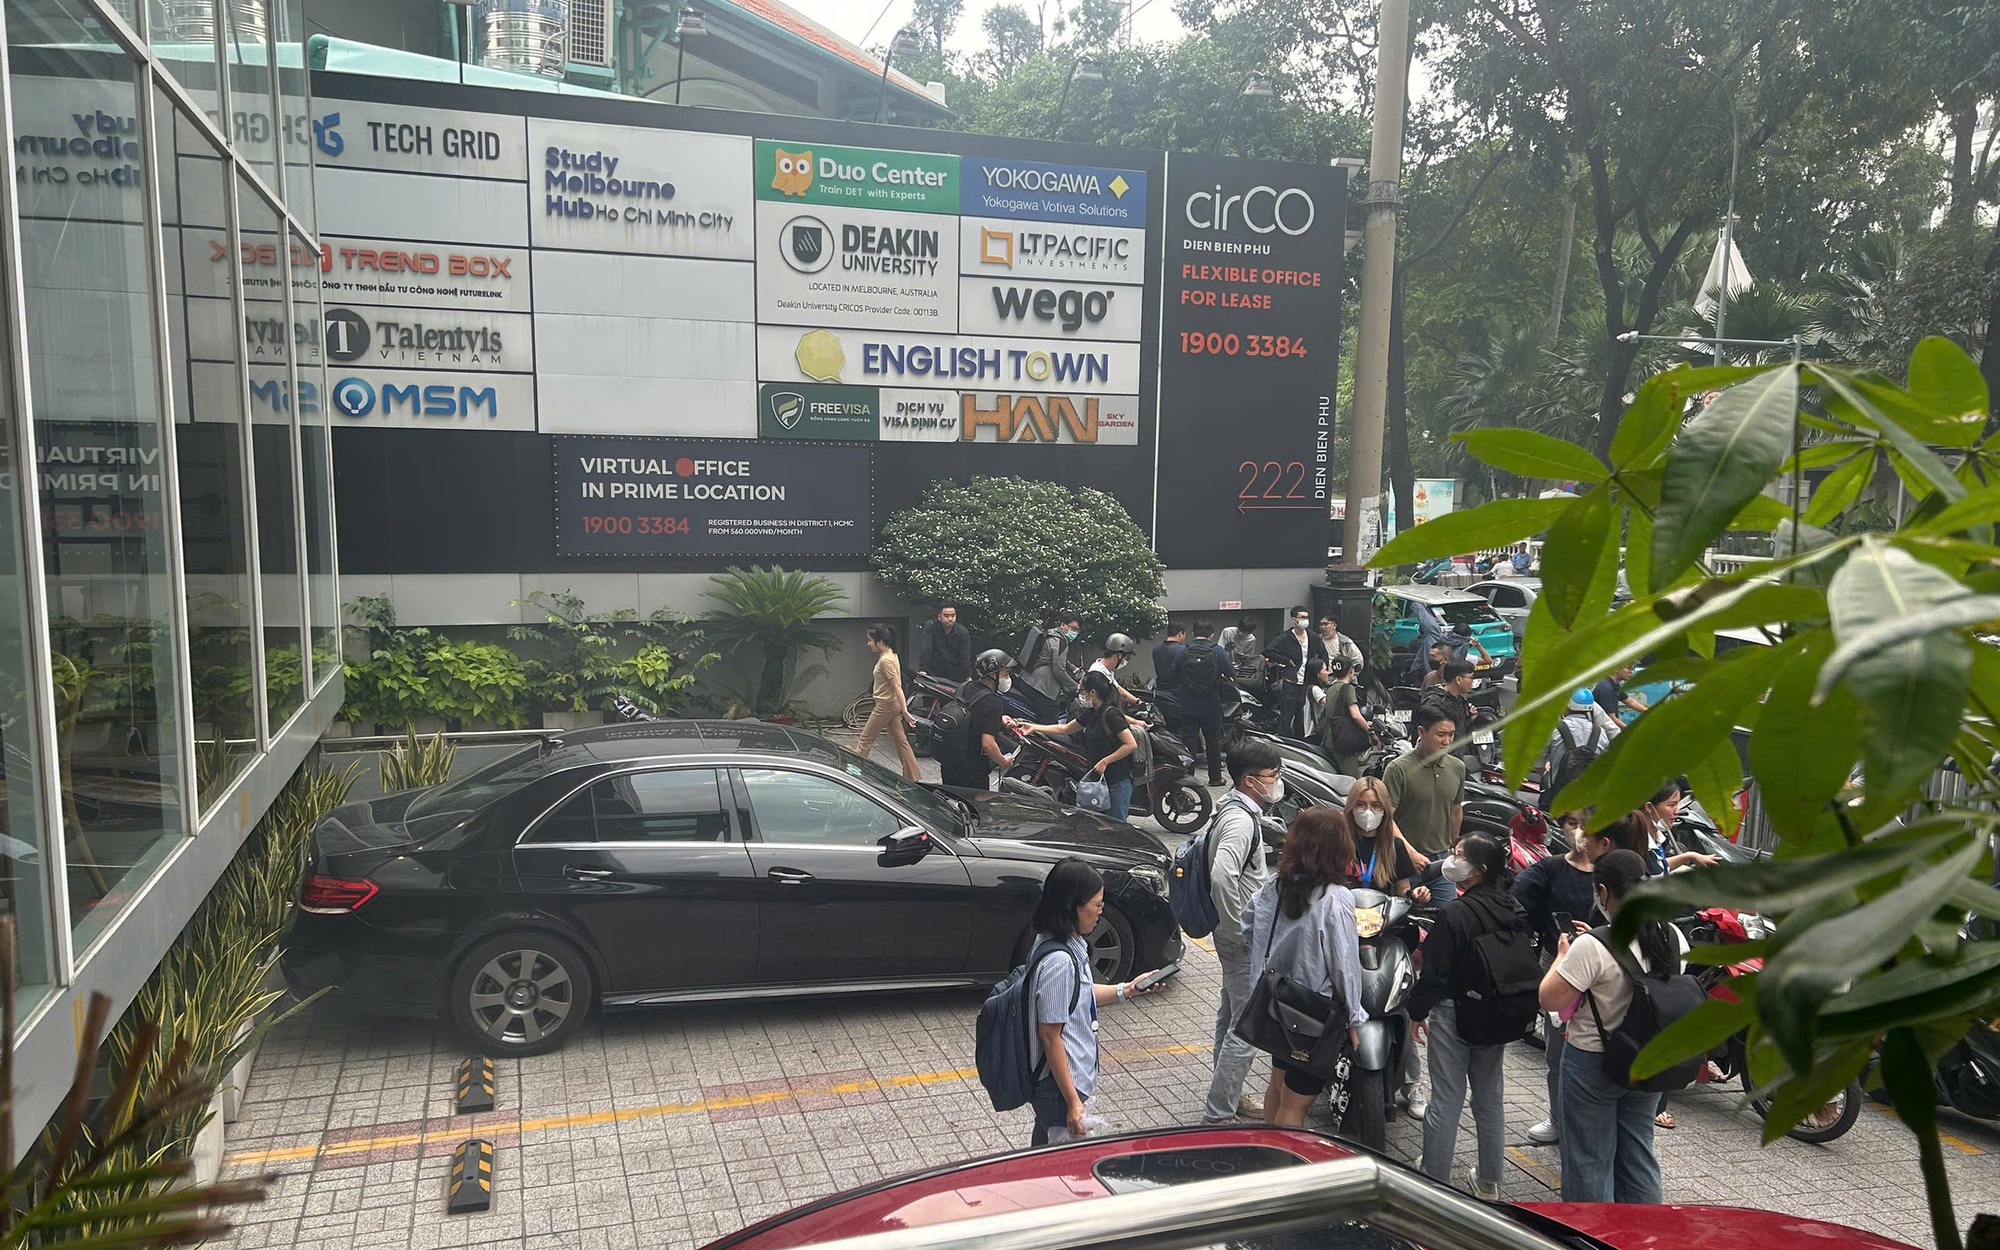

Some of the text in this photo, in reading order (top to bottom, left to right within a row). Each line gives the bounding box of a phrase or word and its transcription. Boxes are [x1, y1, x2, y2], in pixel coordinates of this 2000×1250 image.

[367, 121, 500, 161] TECH GRID
[545, 146, 619, 178] Study
[819, 157, 948, 187] Duo Center
[545, 169, 676, 200] Melbourne
[982, 166, 1101, 195] YOKOGAWA
[819, 184, 926, 201] Train DET with Experts
[546, 194, 734, 232] Hub Ho Chi Minh City
[982, 195, 1128, 218] Yokogawa Votiva Solutions
[1185, 184, 1315, 236] cirCO
[842, 223, 939, 258] DEAKIN
[1183, 239, 1271, 255] DIEN BIEN PHU
[340, 248, 440, 274] TREND
[449, 255, 512, 278] BOX
[842, 253, 938, 277] UNIVERSITY
[1018, 258, 1128, 271] INVESTMENTS
[1181, 264, 1321, 287] FLEXIBLE OFFICE
[322, 281, 341, 290] ÔNG
[355, 284, 377, 292] TNHH
[398, 285, 408, 293] TƯ
[409, 284, 435, 295] CÔNG
[436, 287, 459, 298] NGHỆ
[460, 290, 503, 299] FUTURELINK
[808, 282, 938, 298] LOCATED IN MELBOURNE, AUSTRALIA
[1181, 290, 1272, 309] FOR LEASE
[777, 300, 801, 309] Deakin
[802, 301, 837, 312] University
[838, 304, 864, 313] CRICOS
[865, 305, 893, 314] Provider
[376, 321, 503, 353] Talentvis
[1180, 332, 1307, 358] 1900 3384
[380, 350, 502, 364] VIETNAM
[862, 343, 1109, 382] ENGLISH TOWN
[382, 383, 498, 418] MSM
[810, 402, 871, 415] FREEVISA
[896, 402, 944, 417] DỊCH VỤ
[883, 416, 957, 431] VISA ĐỊNH CƯ
[962, 393, 1099, 443] HAN
[1098, 420, 1135, 428] GARDEN
[1314, 396, 1330, 499] DIEN BIEN PHU
[580, 457, 673, 475] VIRTUAL
[581, 482, 786, 501] IN PRIME LOCATION
[1238, 461, 1306, 499] 222
[582, 516, 690, 535] 1900 3384
[753, 519, 788, 527] BUSINESS
